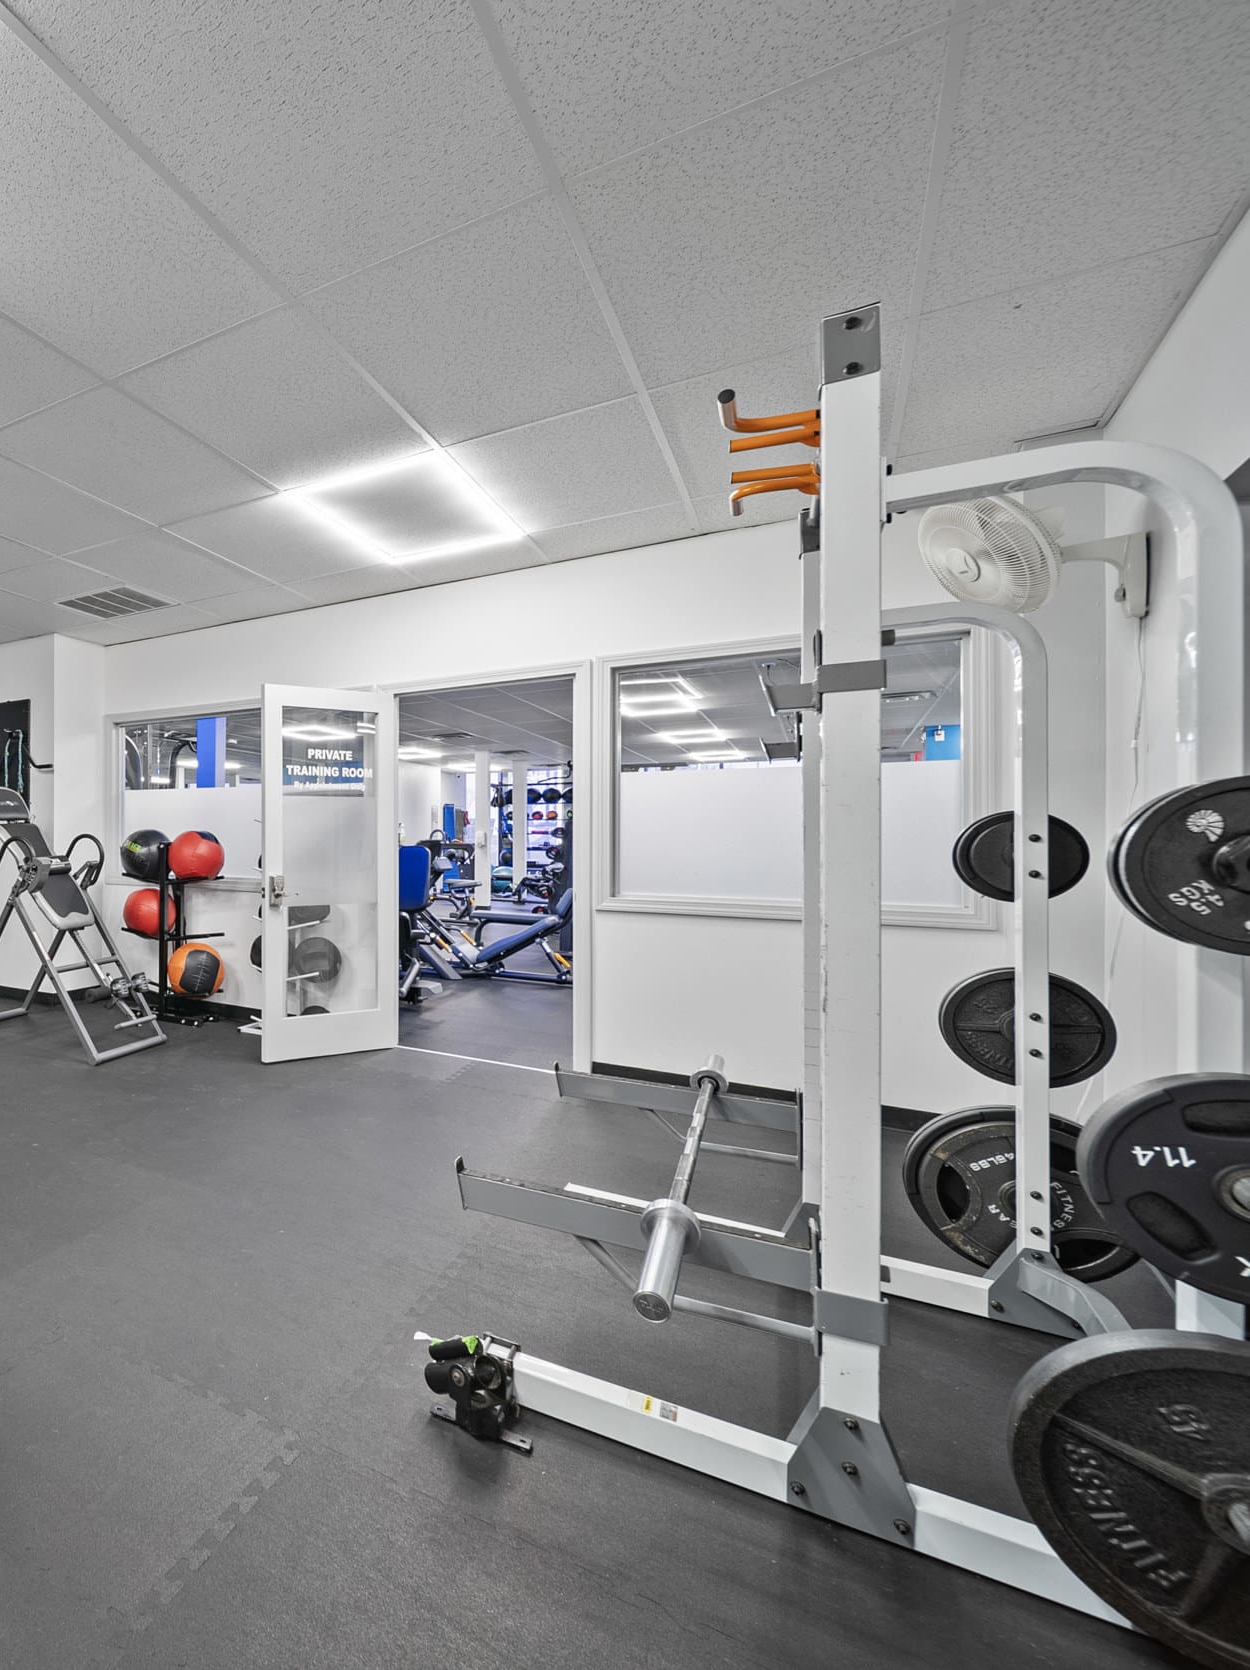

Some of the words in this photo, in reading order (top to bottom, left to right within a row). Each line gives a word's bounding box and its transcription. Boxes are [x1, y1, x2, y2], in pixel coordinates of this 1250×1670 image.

[307, 748, 353, 761] PRIVATE
[286, 765, 340, 777] TRAINING
[342, 767, 373, 778] ROOM
[1131, 1146, 1197, 1168] 11.4
[1050, 1181, 1076, 1231] FITNES
